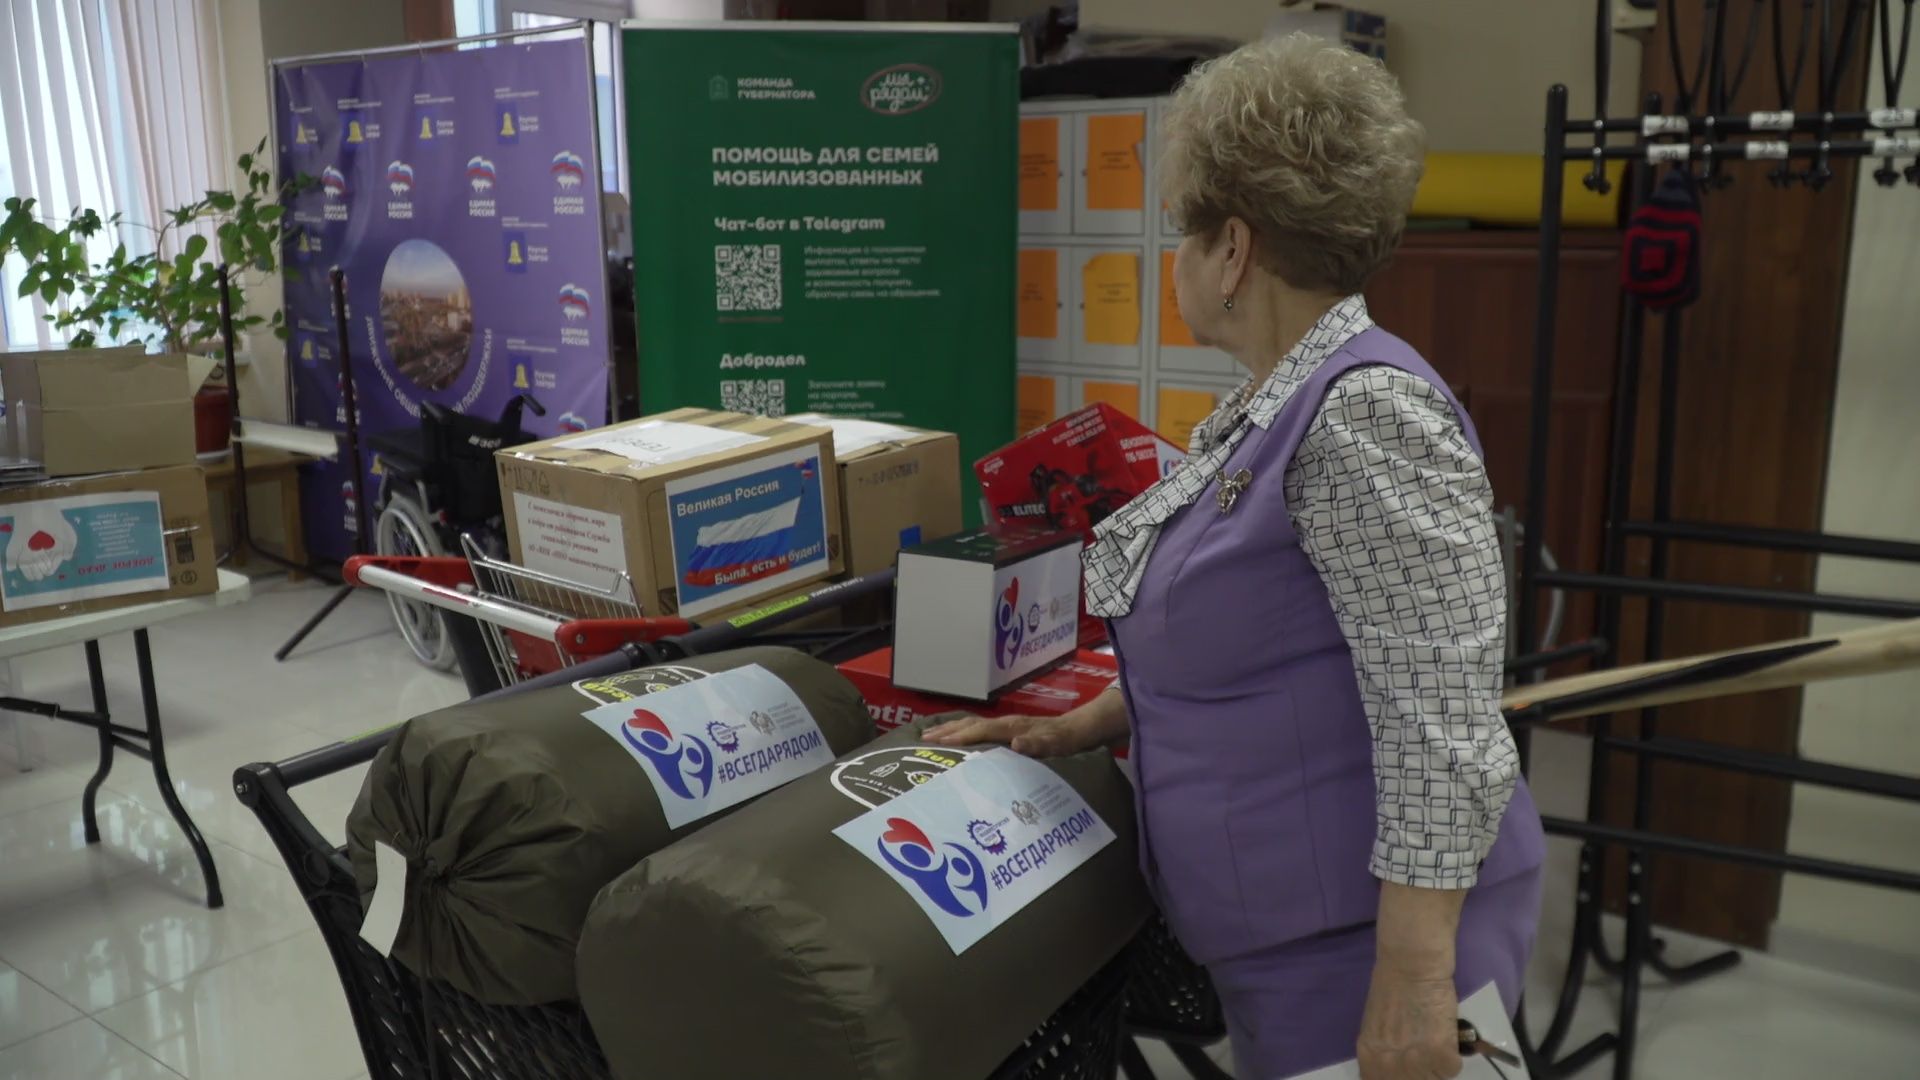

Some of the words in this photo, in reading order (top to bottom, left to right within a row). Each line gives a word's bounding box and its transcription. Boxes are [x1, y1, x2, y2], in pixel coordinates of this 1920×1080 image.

[737, 78, 793, 88] КОМАНДА
[738, 89, 816, 100] ГУБЕРНАТОРА
[870, 86, 928, 112] рядом
[712, 147, 812, 165] ПОМОЩЬ
[817, 147, 860, 165] ДЛЯ
[866, 143, 939, 164] СЕМЕЙ
[713, 169, 922, 187] МОБИЛИЗОВАННЫХ
[714, 217, 785, 231] Чат-бот
[789, 220, 800, 230] в
[802, 216, 885, 234] Telegram
[462, 328, 492, 410] ПОДДЕРЖКИ
[720, 353, 806, 370] Добродел
[676, 493, 732, 517] Великая
[734, 480, 780, 500] Россия
[714, 567, 749, 586] Была,
[751, 559, 778, 574] есть
[788, 542, 821, 562] будет!
[718, 730, 823, 784] #ВСЕГДАРЯДОМ
[990, 808, 1096, 891] #ВСЕГДАРЯДОМ
